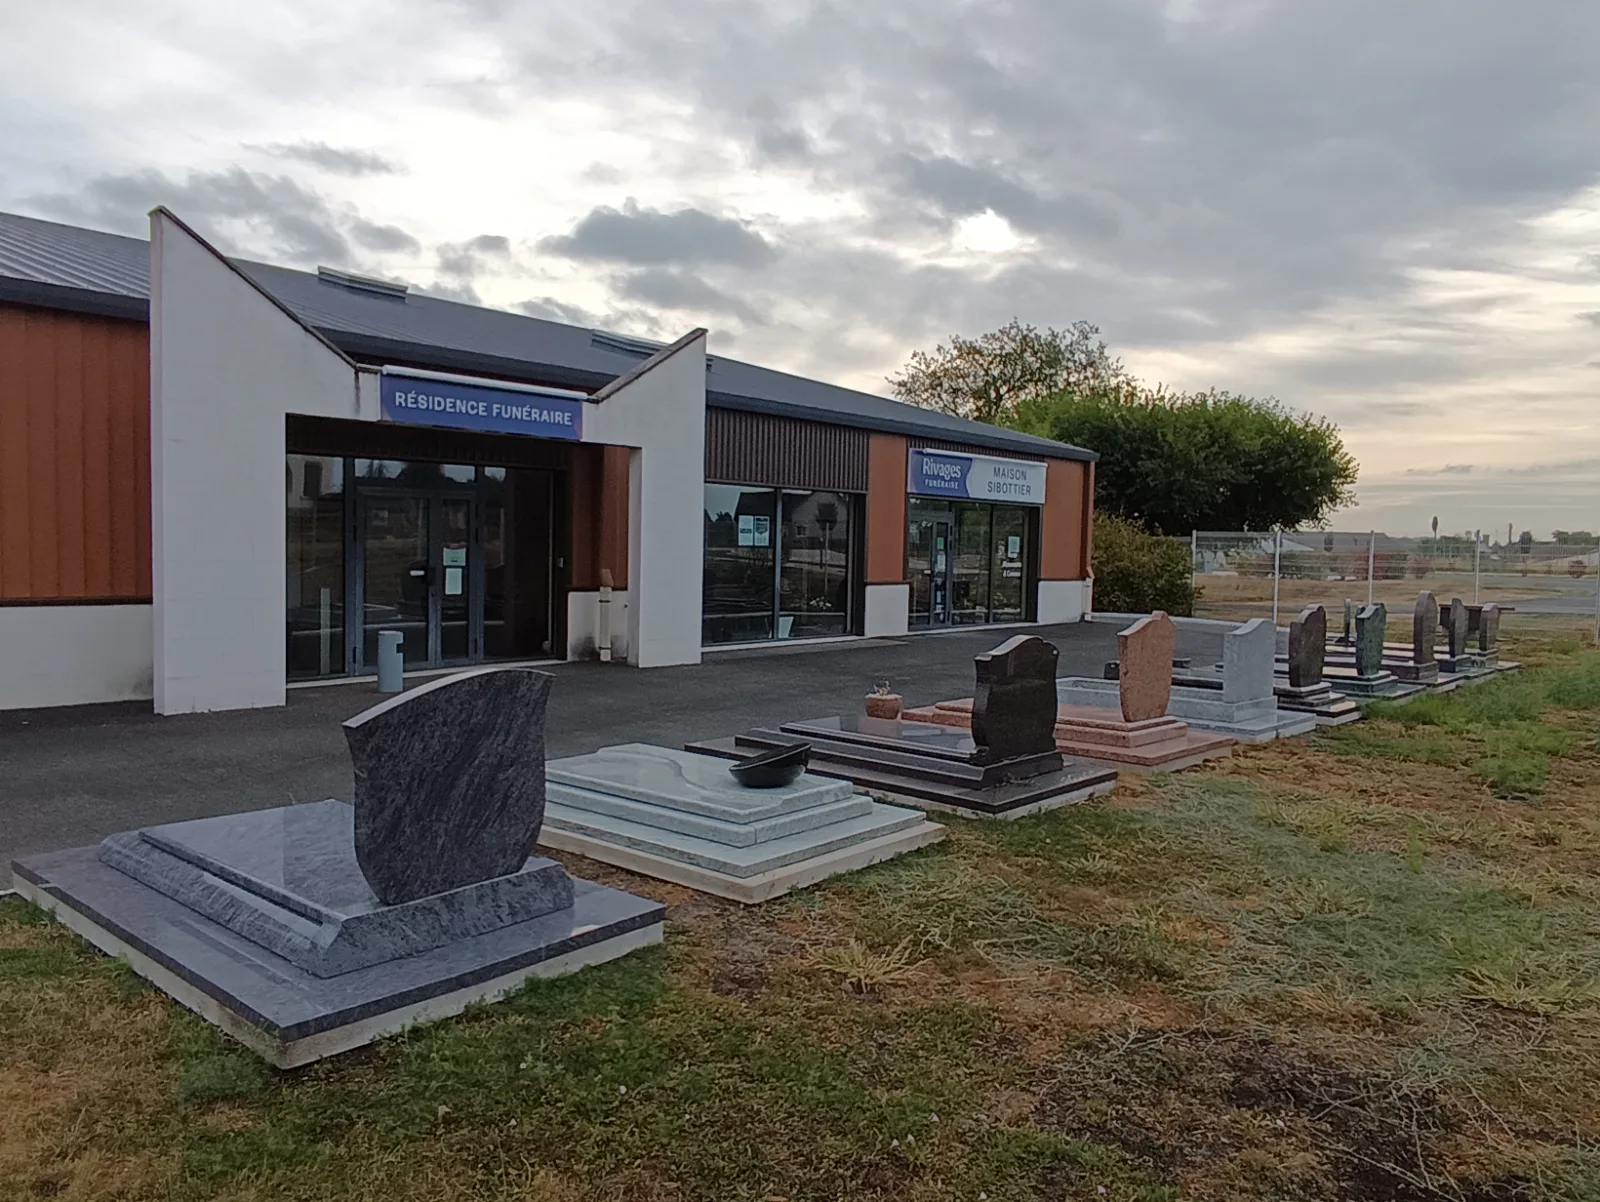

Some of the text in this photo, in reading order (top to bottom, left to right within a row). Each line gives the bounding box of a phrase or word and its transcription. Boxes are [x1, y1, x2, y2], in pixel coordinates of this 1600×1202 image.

[395, 390, 572, 425] RÉSIDENCE FUNÉRAIRE
[922, 457, 961, 480] Rivages
[993, 466, 1027, 480] MAISON
[987, 481, 1031, 496] SIBOTTIER
